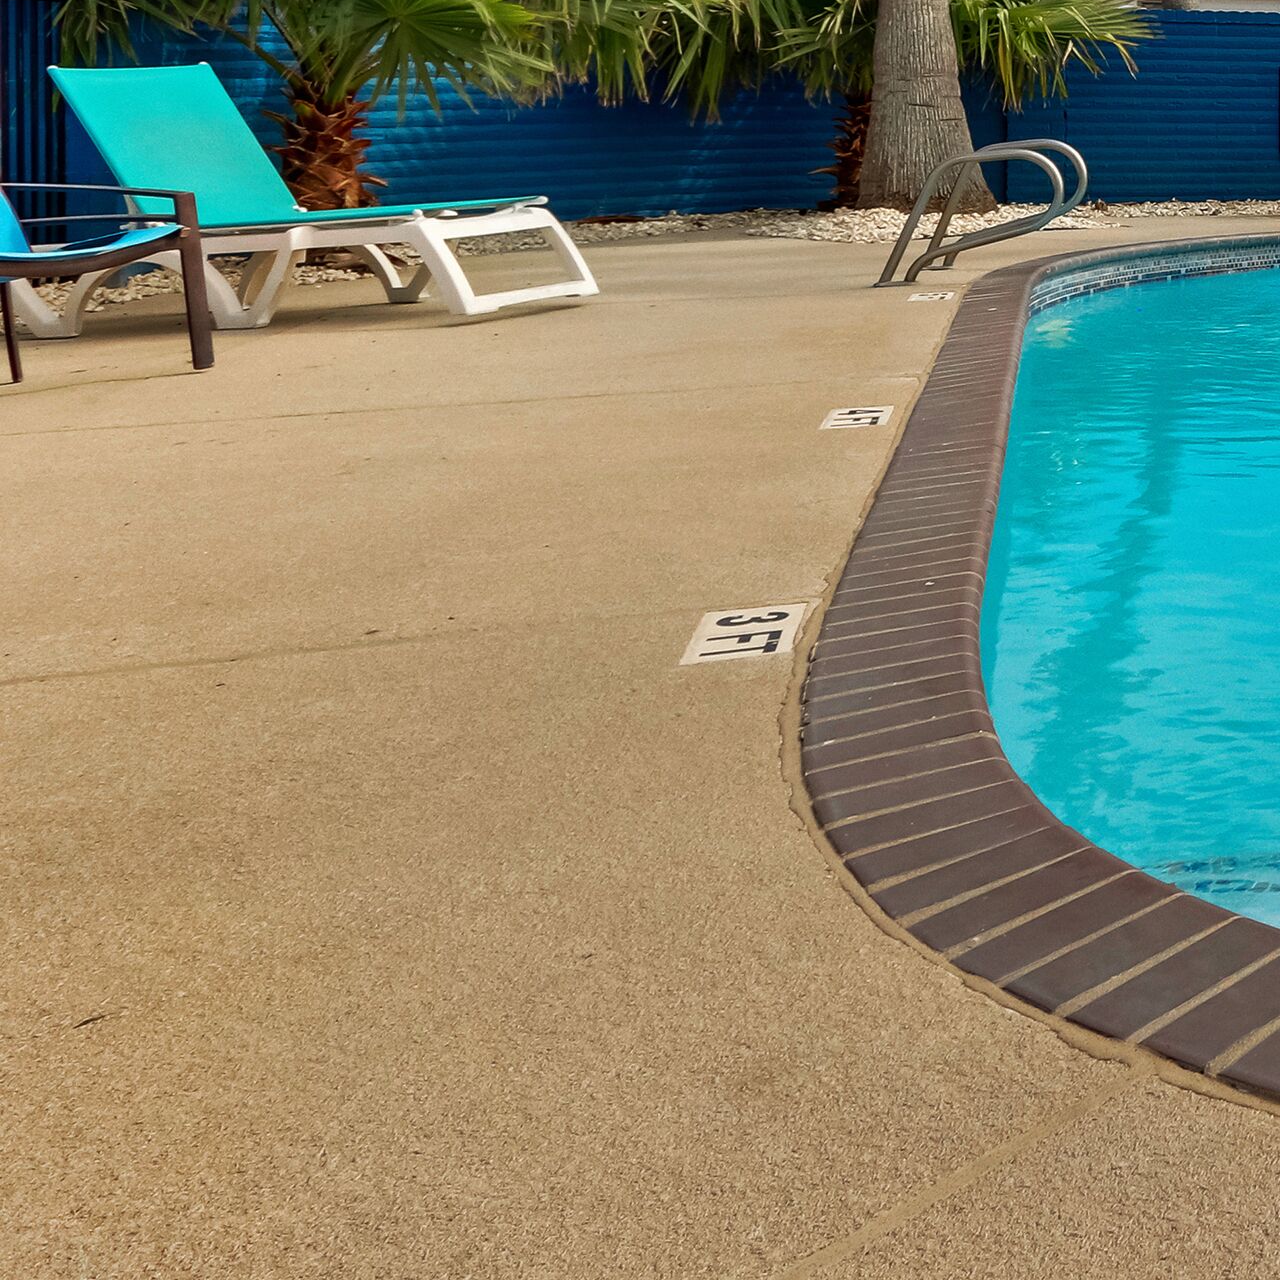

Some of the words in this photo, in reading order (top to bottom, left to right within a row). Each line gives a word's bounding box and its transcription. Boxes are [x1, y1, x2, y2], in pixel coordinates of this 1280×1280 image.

[830, 416, 880, 427] FT
[716, 611, 790, 627] 3
[698, 629, 783, 657] FT
